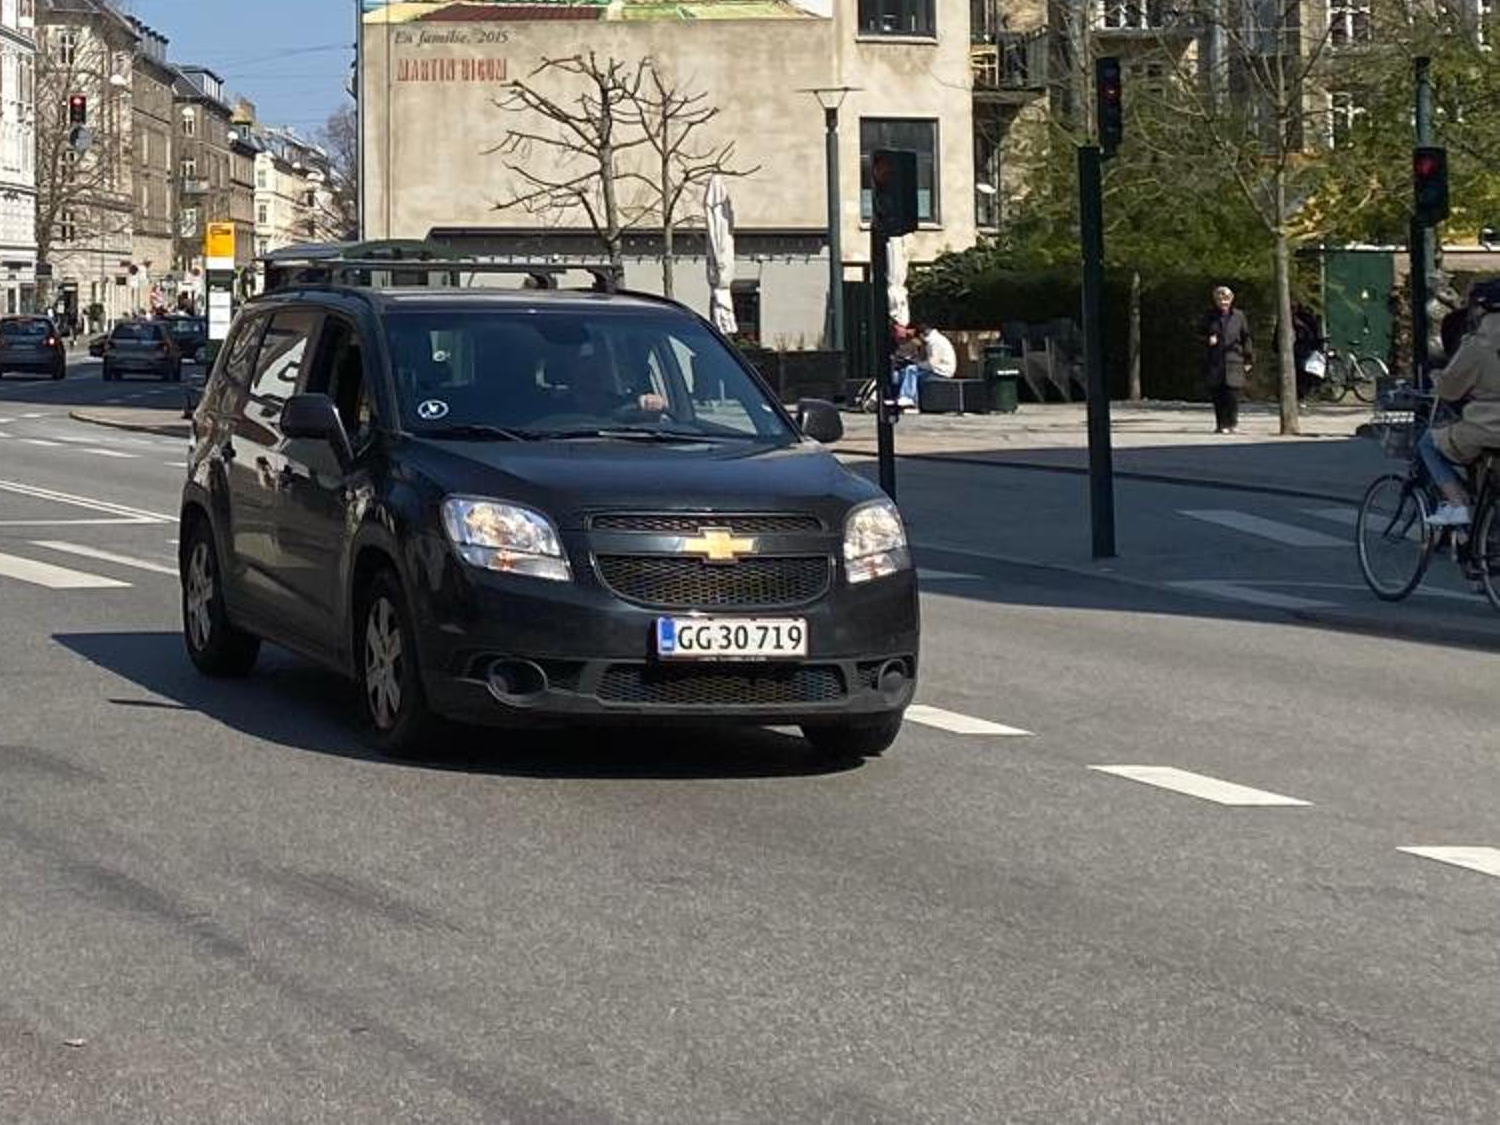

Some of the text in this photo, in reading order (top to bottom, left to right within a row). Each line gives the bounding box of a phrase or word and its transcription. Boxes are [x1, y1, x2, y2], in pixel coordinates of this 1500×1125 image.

[394, 30, 413, 44] En
[477, 30, 509, 44] 2015
[677, 625, 803, 650] GG 30 719
